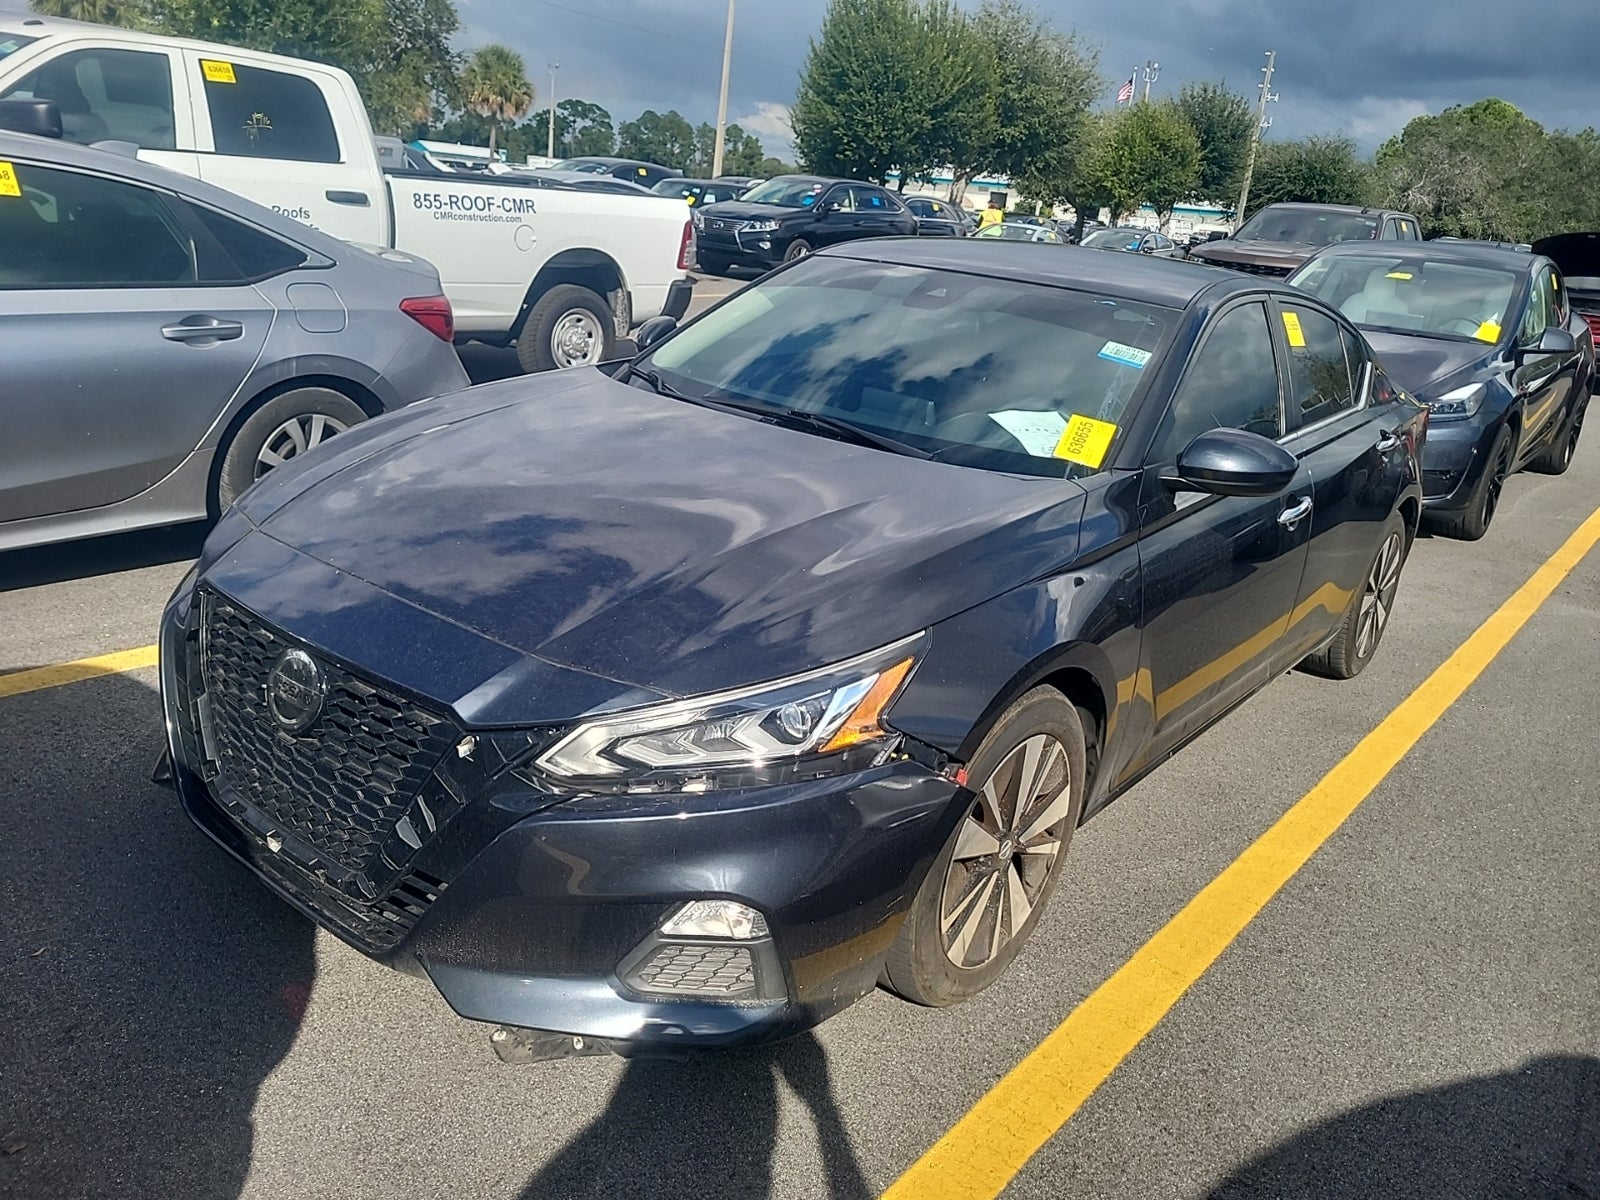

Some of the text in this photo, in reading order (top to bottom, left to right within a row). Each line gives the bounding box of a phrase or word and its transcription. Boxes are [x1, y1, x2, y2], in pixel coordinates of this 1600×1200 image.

[413, 193, 537, 214] 855-ROOF-CMR
[433, 211, 522, 223] CMRconstruction.com
[1067, 421, 1094, 454] 636655
